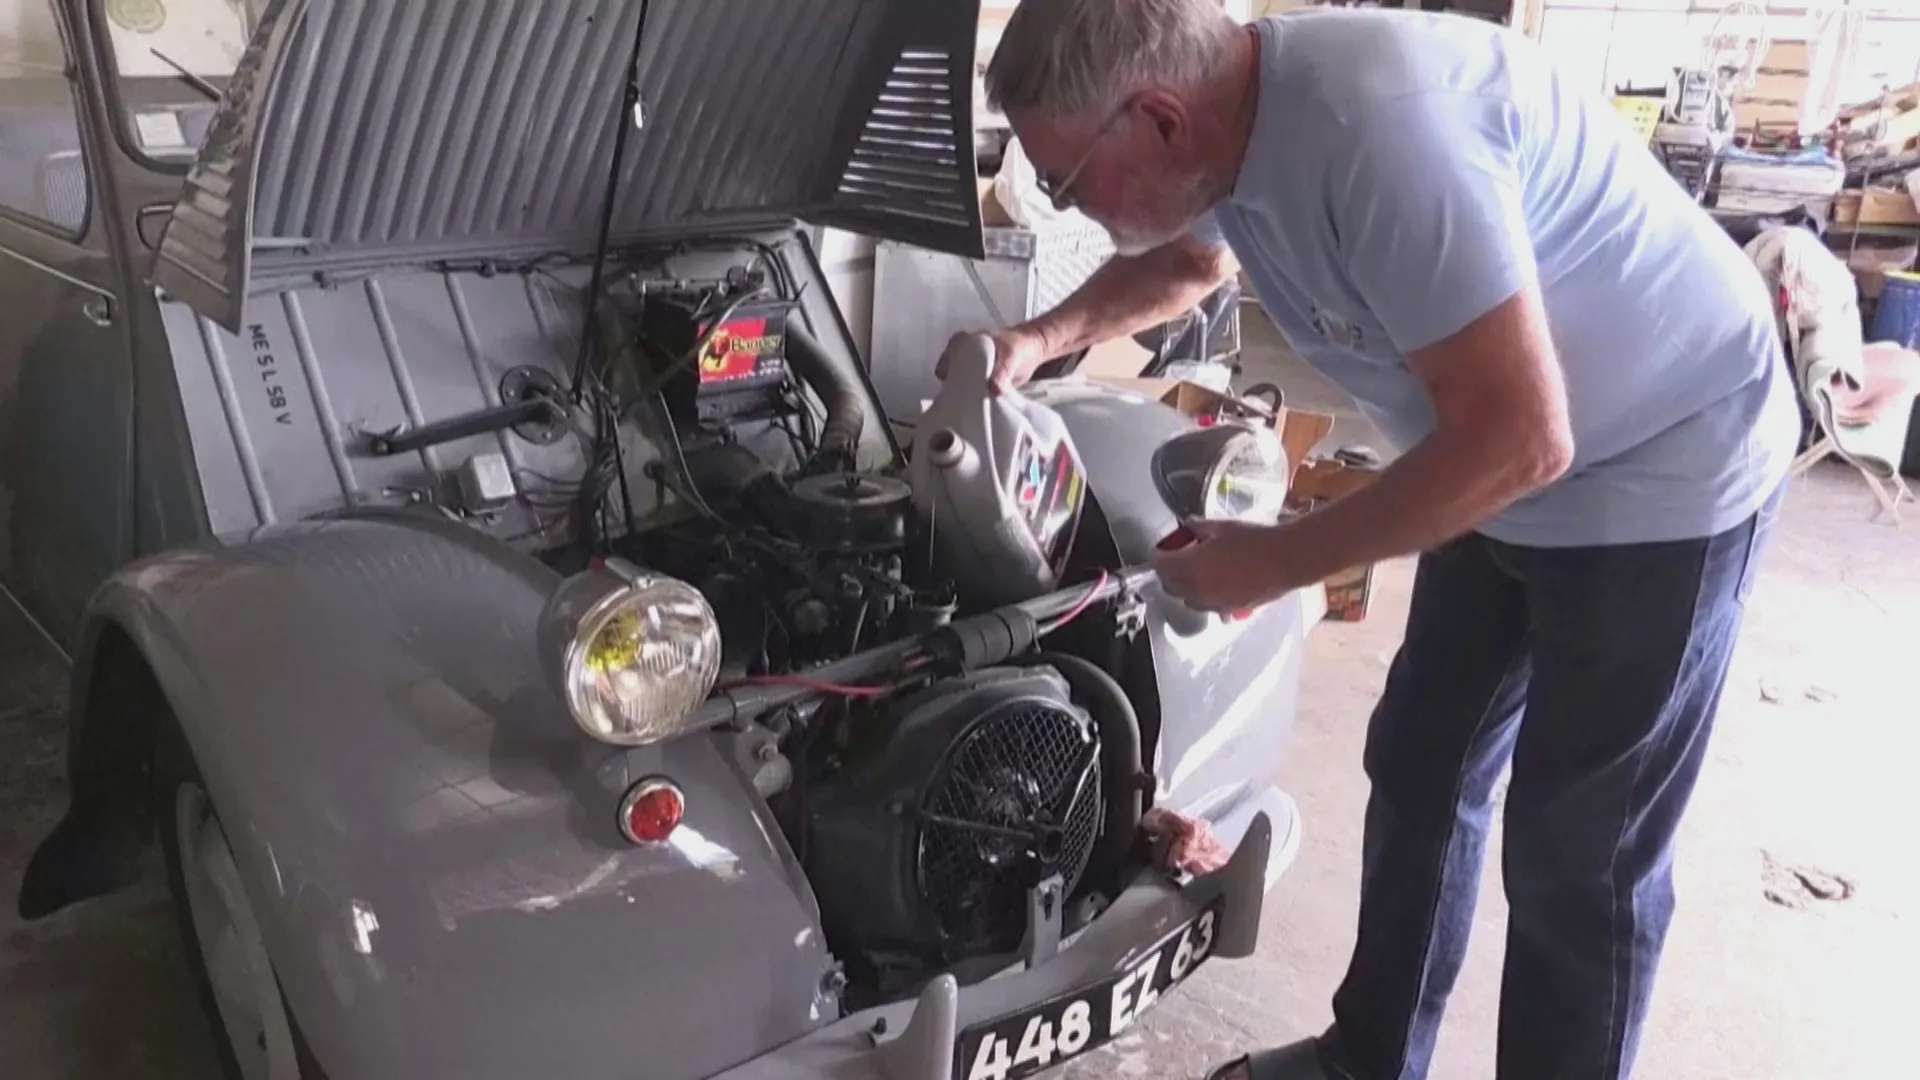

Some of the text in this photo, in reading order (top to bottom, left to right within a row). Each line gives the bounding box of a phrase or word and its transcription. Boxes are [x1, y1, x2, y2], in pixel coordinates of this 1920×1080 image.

[968, 909, 1215, 1080] 448 EZ 63
